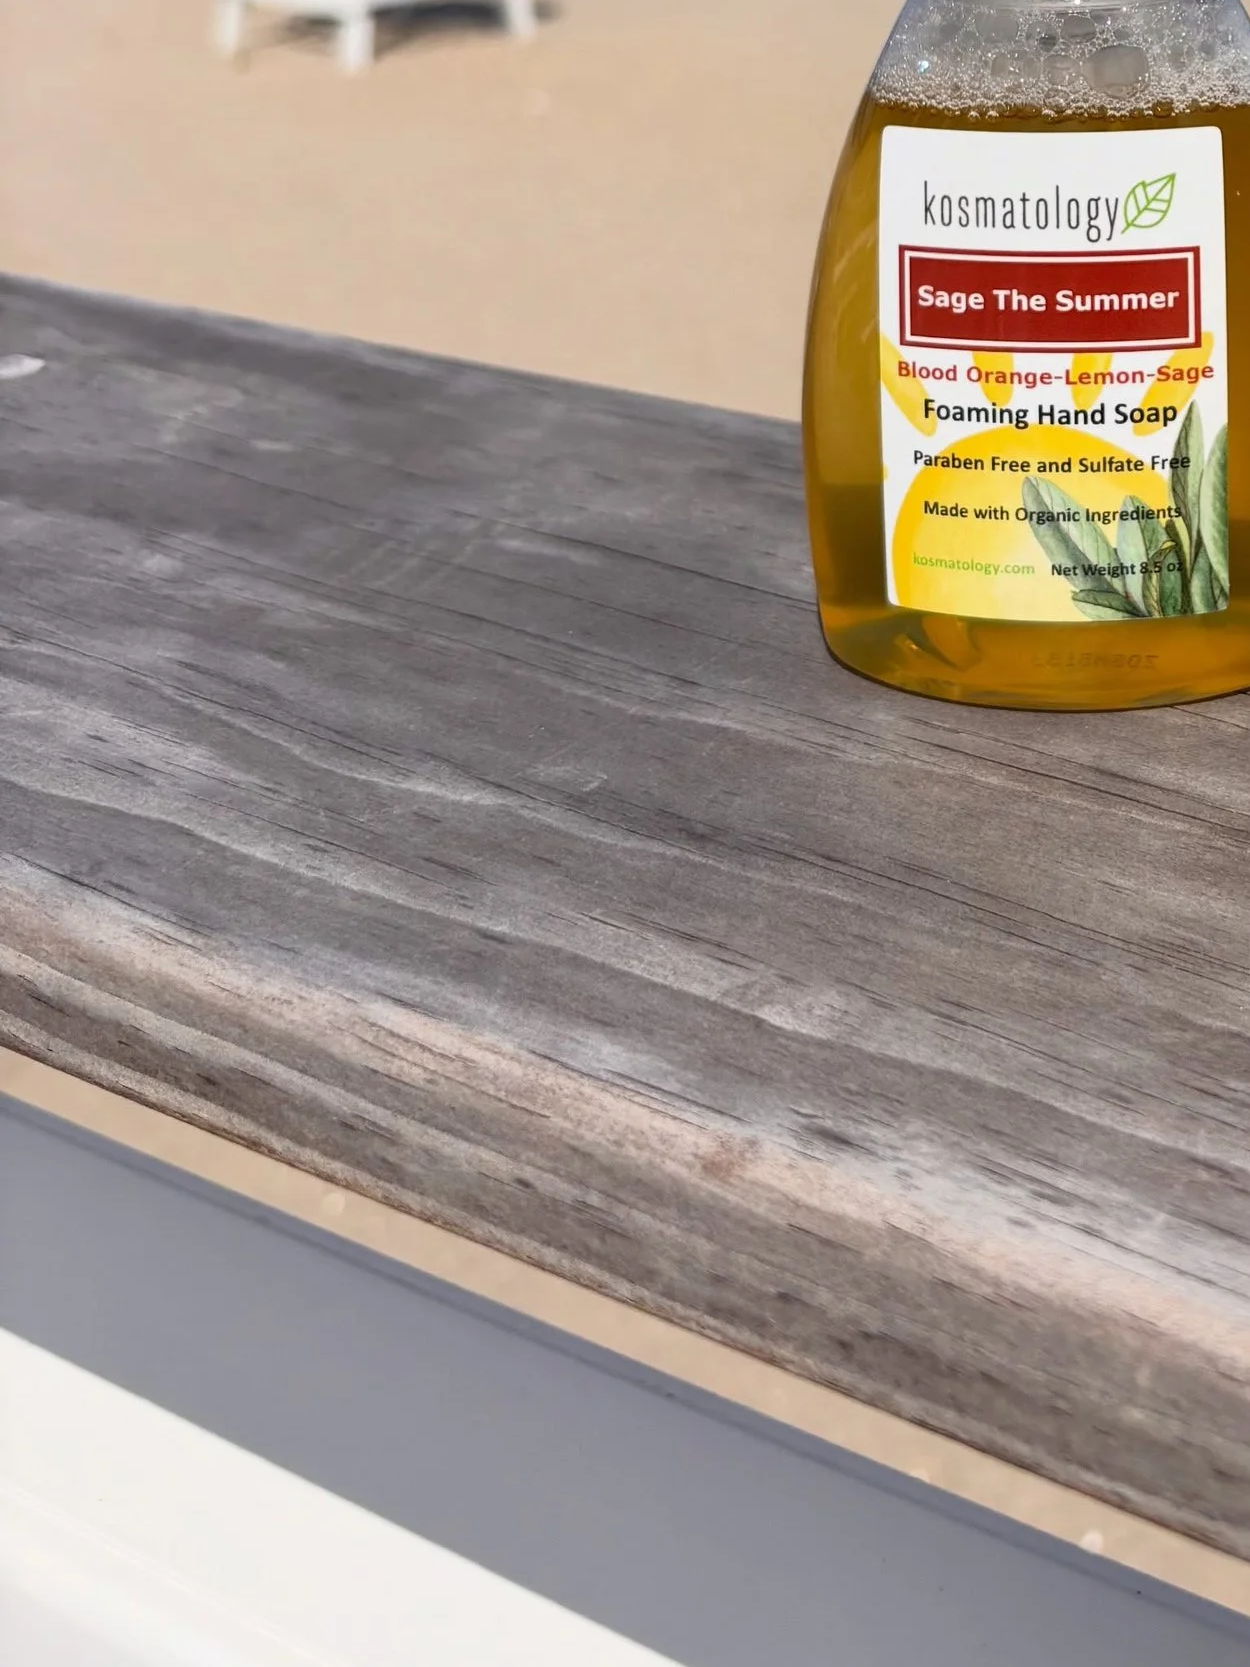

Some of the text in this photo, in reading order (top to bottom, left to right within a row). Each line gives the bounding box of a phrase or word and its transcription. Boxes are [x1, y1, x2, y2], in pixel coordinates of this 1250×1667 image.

[924, 180, 1119, 243] kosmatology
[917, 285, 1180, 314] Sage The Summer
[897, 361, 1215, 389] Blood Orange-Lemon-Sage
[924, 398, 1178, 429] Foaming Hand Soap
[913, 450, 1191, 473] Paraben Free and Sulfate Free
[924, 500, 1182, 525] Made with Organic Ingredients
[913, 552, 1035, 576] kosmatology.com
[1051, 561, 1184, 579] Net Weight 8.5 oz
